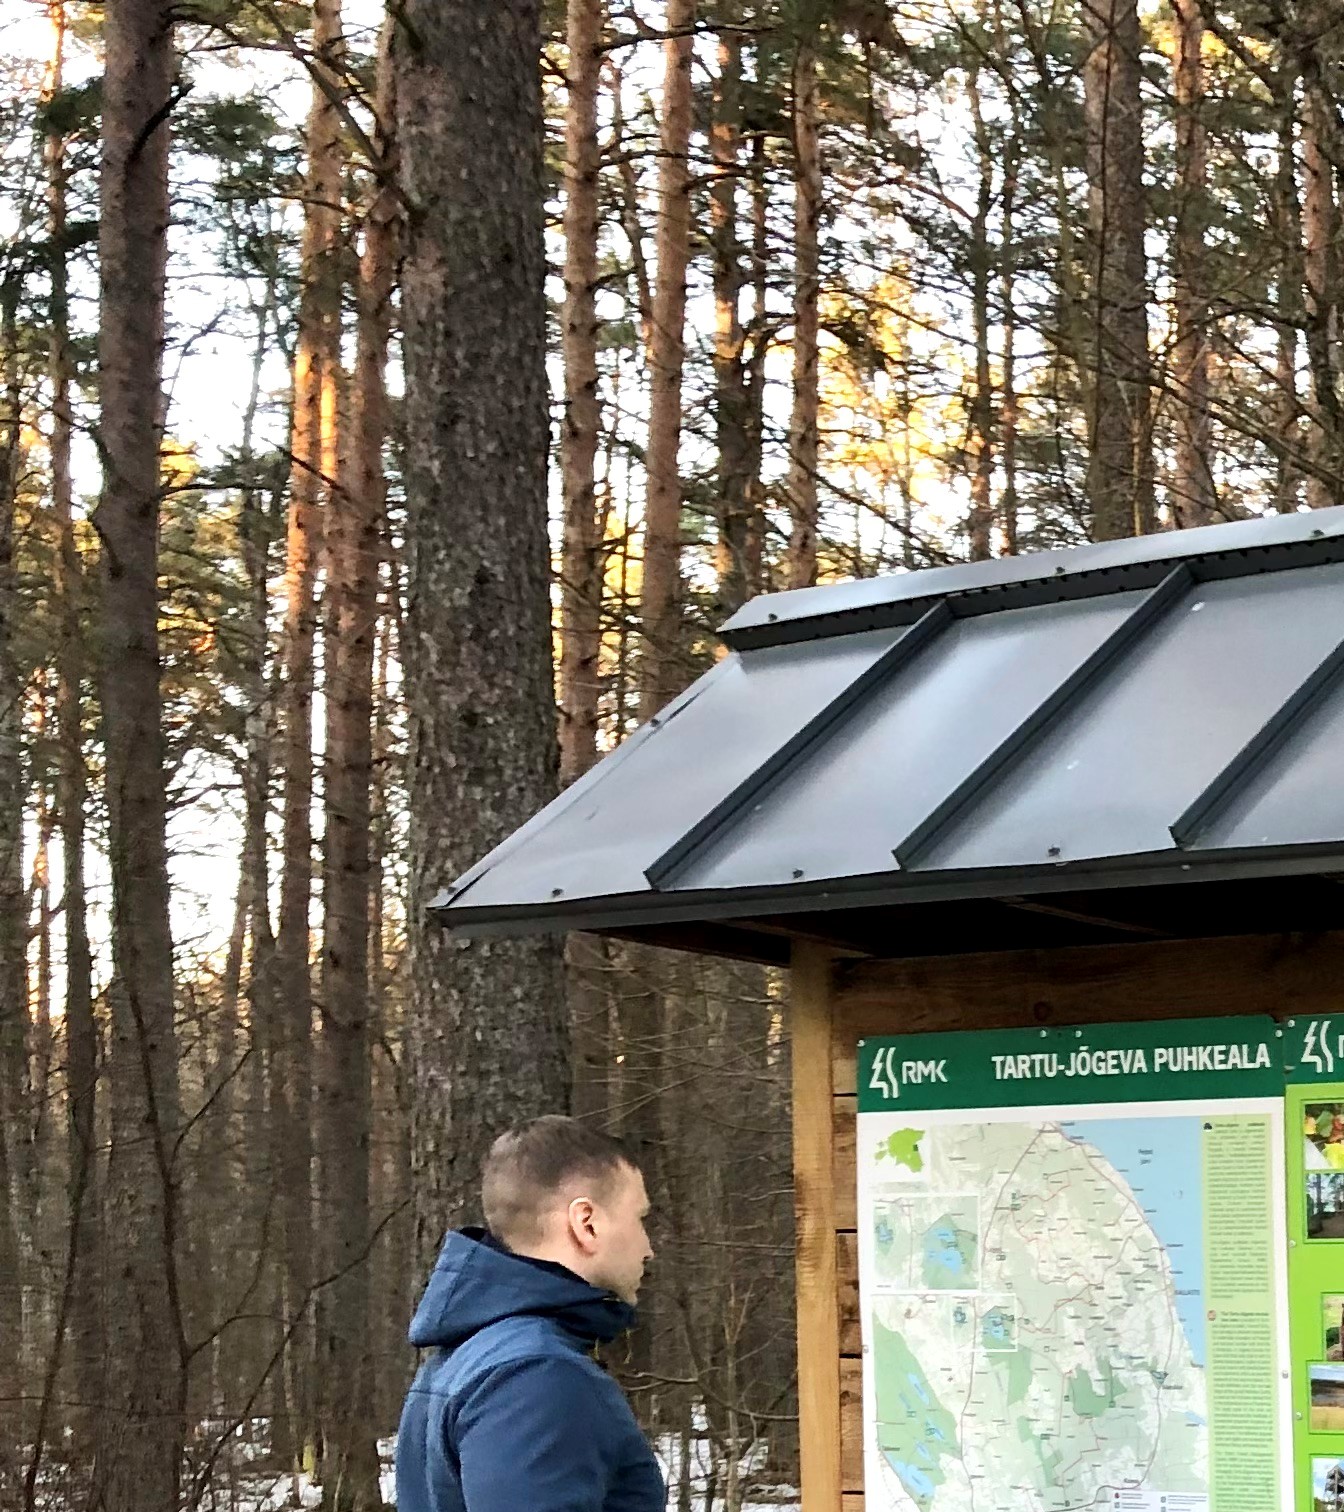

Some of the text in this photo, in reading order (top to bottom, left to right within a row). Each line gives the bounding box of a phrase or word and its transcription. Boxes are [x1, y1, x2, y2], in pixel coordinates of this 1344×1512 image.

[902, 1059, 948, 1085] RMK
[992, 1043, 1271, 1080] TARTU-JÕGEVA PUHKEALA
